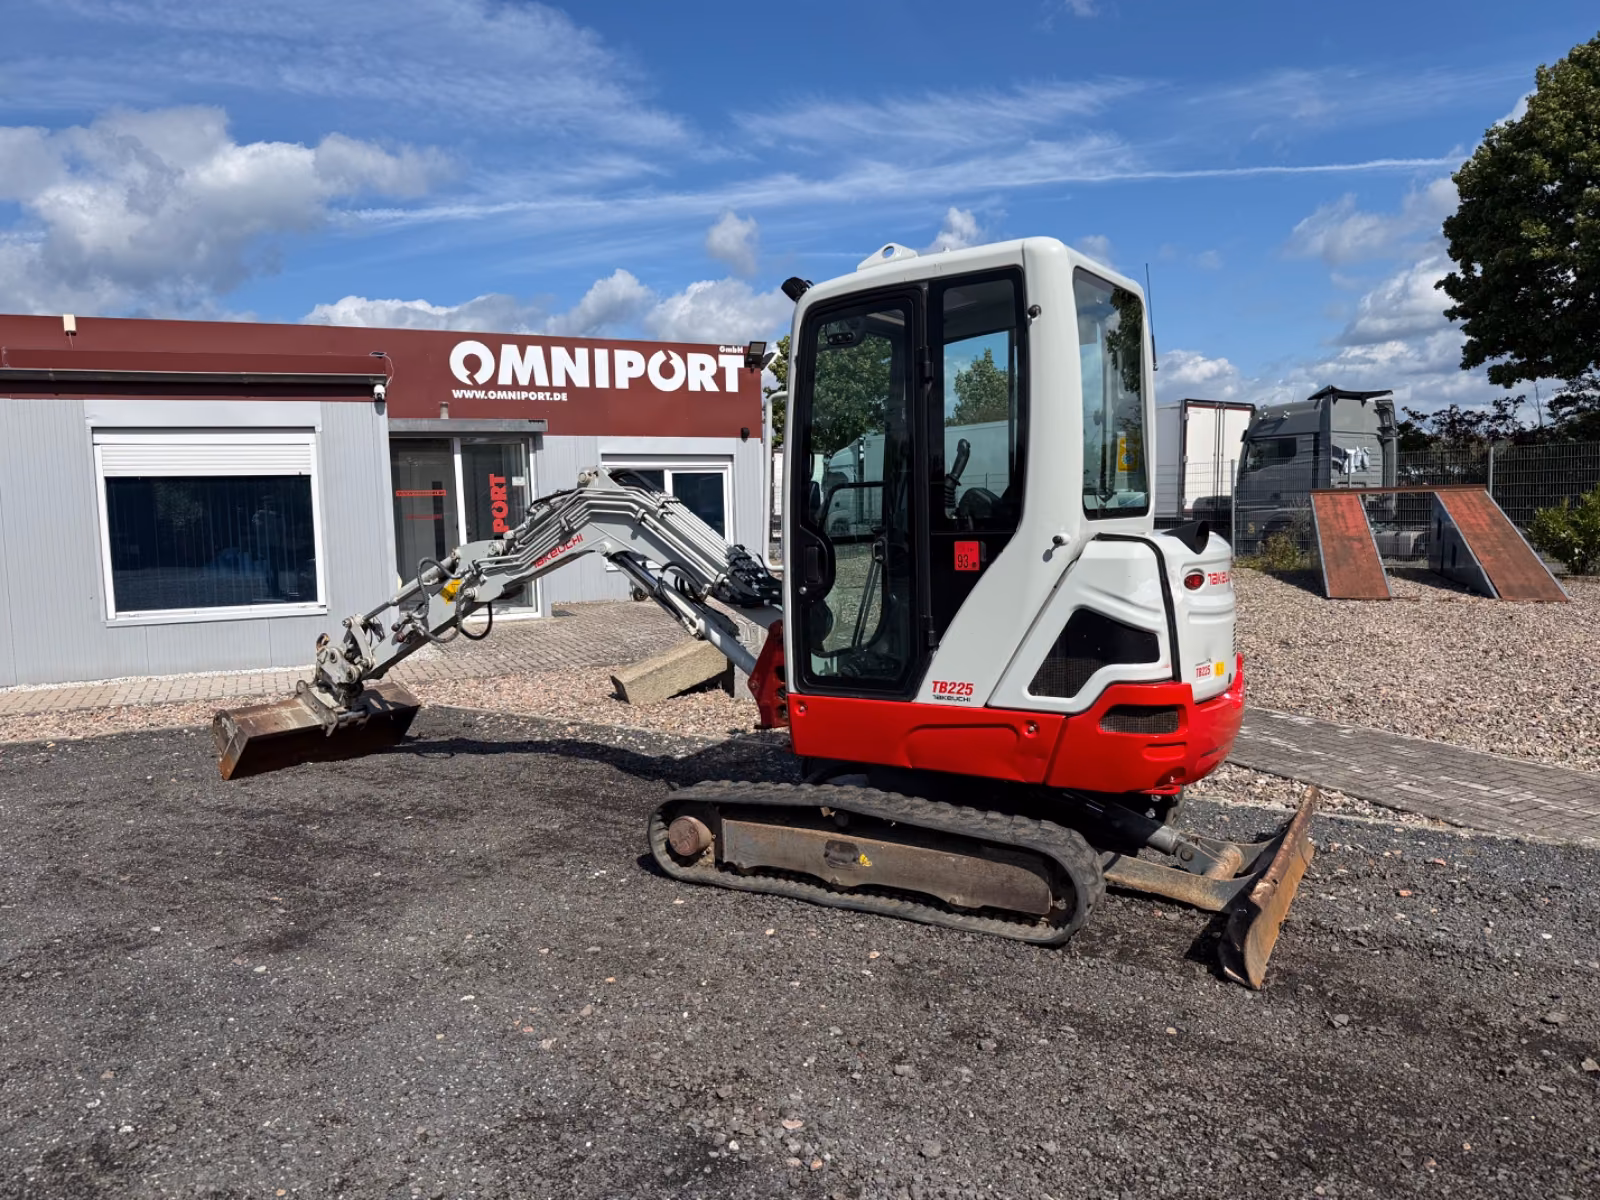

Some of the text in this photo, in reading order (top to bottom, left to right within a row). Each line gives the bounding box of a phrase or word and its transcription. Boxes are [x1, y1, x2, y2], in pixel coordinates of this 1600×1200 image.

[719, 345, 744, 354] GmbH
[449, 340, 745, 393] OMNIPORT
[452, 389, 568, 401] WWW.OMNIPORT.DE
[957, 553, 969, 569] 93
[932, 680, 974, 696] TB225
